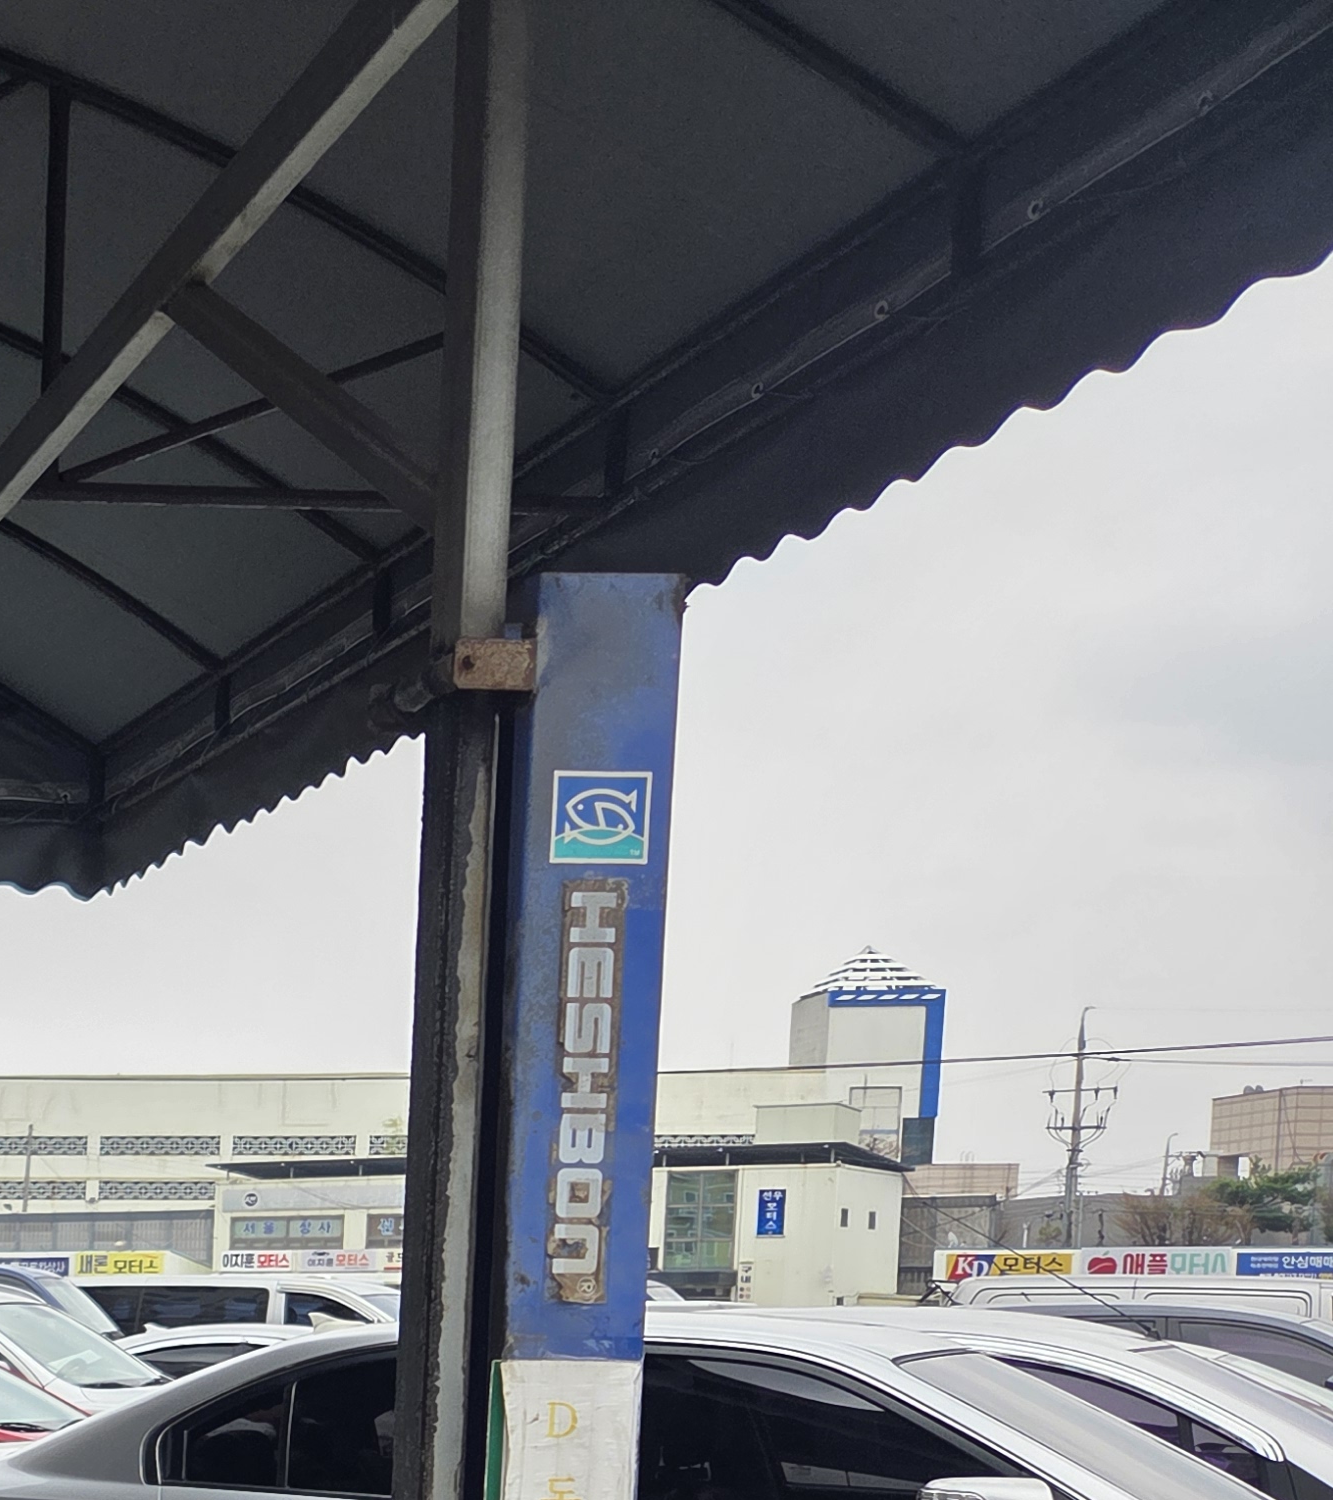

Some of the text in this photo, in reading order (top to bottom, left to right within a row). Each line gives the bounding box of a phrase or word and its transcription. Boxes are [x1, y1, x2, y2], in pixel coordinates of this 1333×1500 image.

[552, 891, 618, 1275] HESHBON
[78, 1254, 108, 1274] 새론
[113, 1260, 159, 1274] 모터스
[222, 1253, 289, 1268] 이지훈 모터스
[335, 1253, 369, 1267] 모터스
[955, 1256, 1063, 1277] KD 모터스
